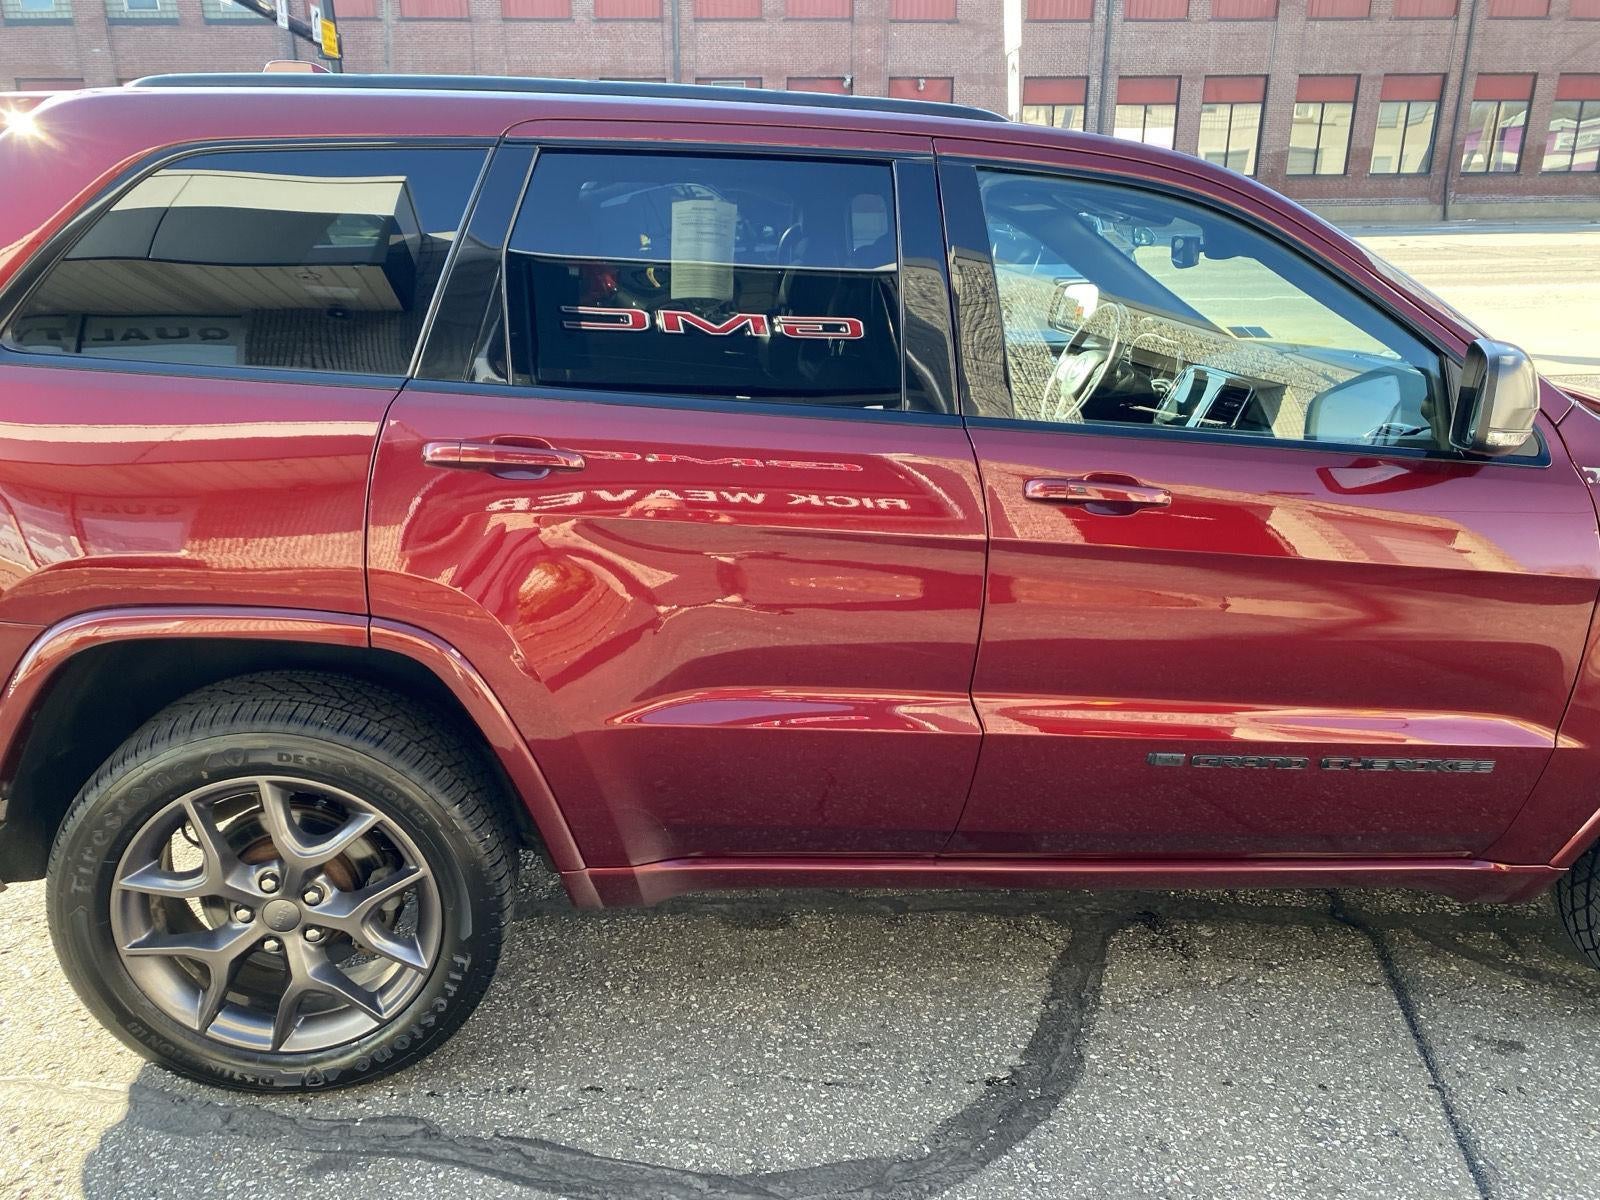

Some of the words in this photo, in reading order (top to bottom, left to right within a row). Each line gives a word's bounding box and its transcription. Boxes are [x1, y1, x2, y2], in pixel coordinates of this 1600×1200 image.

[1190, 754, 1310, 770] GRAND
[1320, 756, 1497, 773] CHEROKEE
[354, 952, 472, 1072] Firestone
